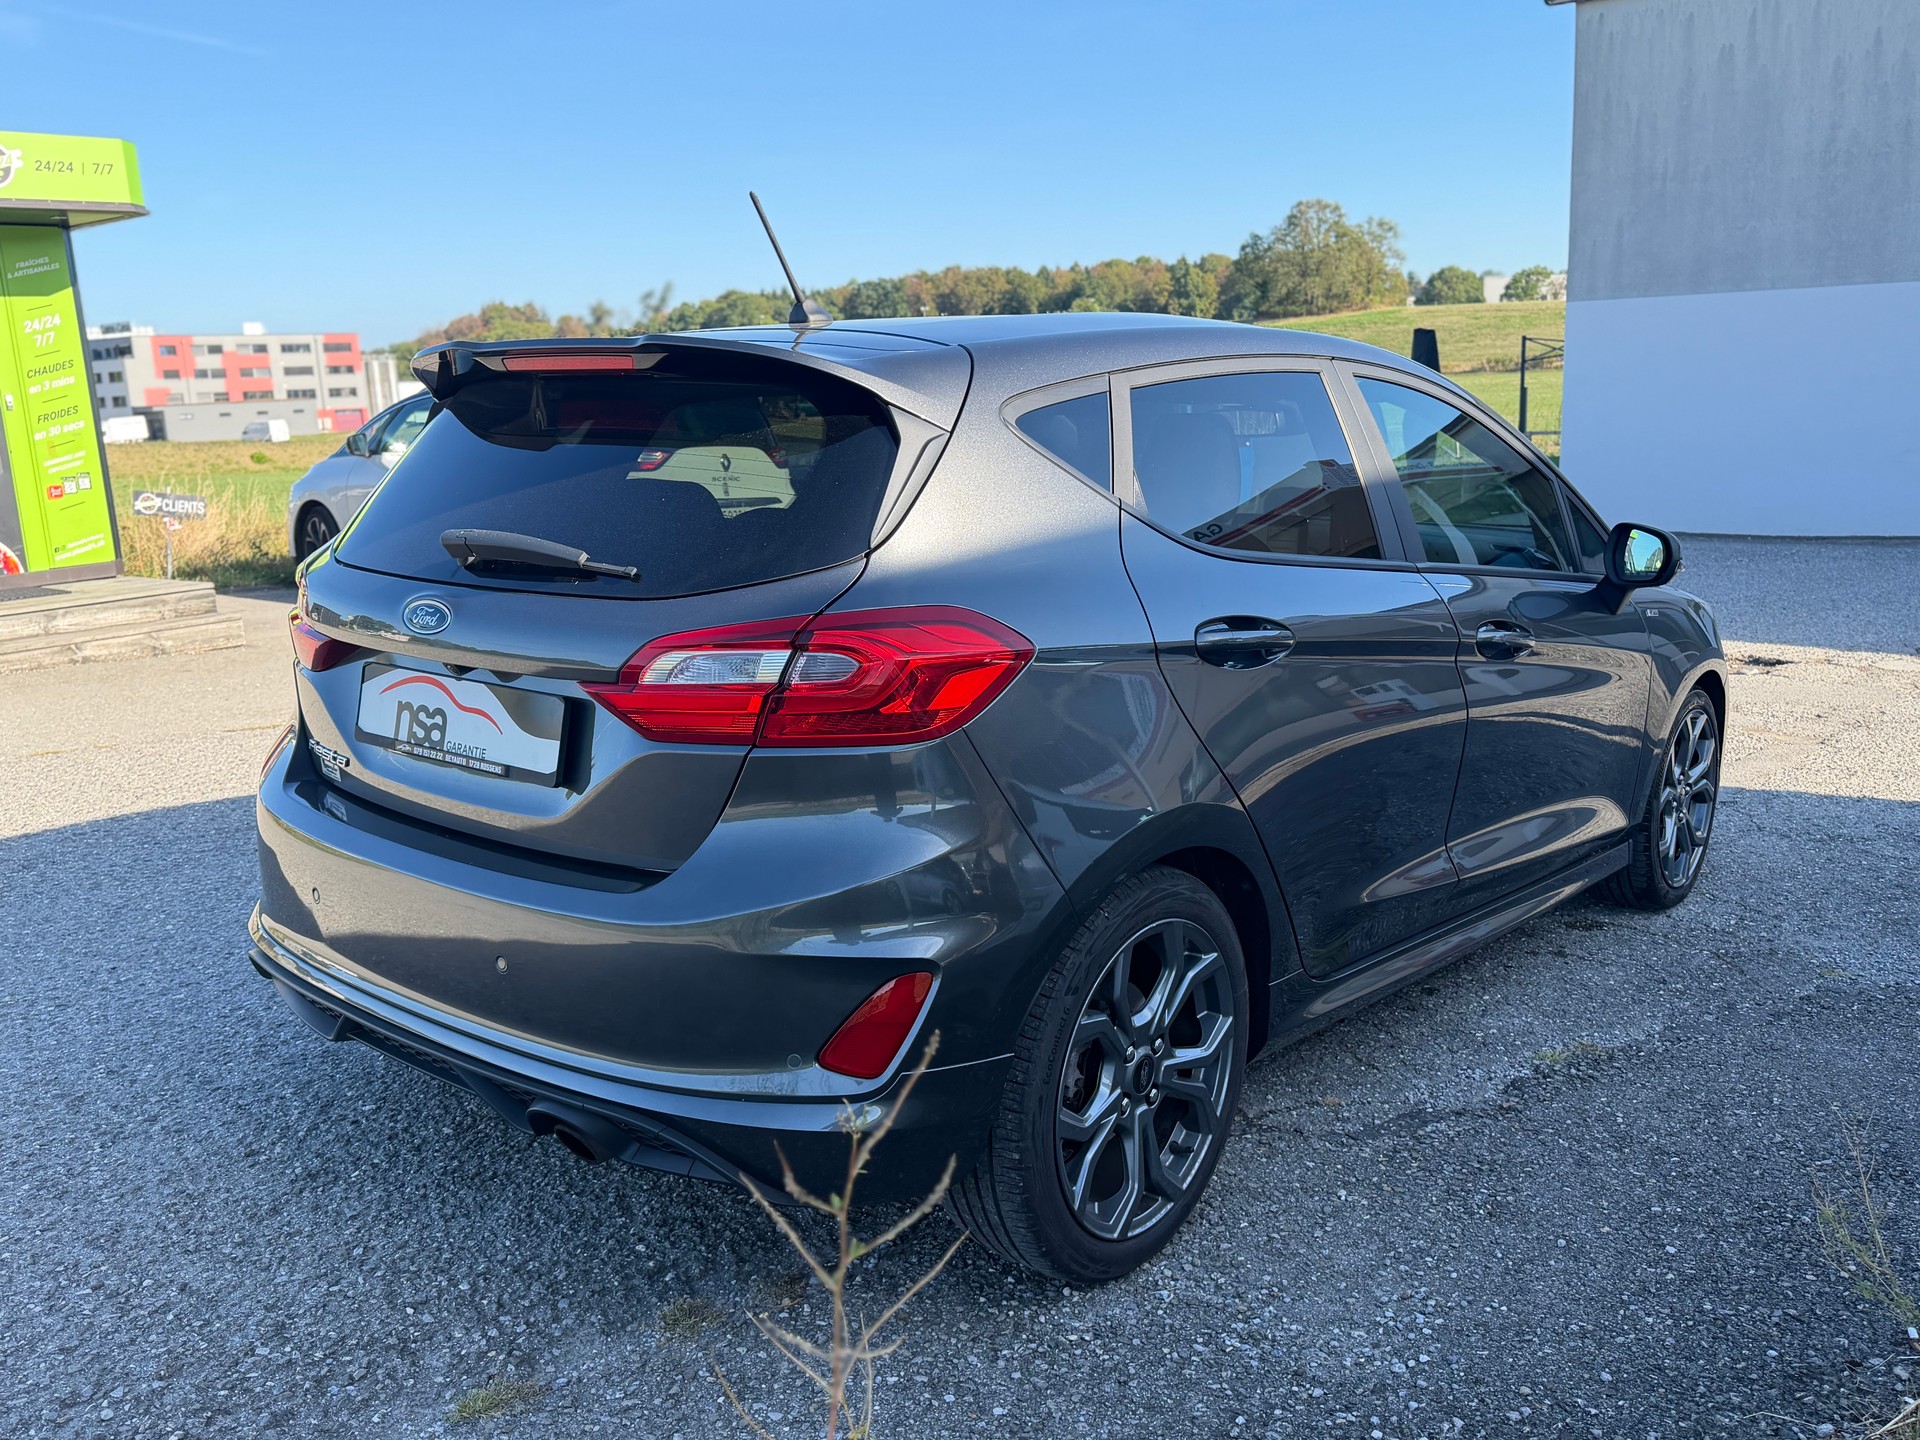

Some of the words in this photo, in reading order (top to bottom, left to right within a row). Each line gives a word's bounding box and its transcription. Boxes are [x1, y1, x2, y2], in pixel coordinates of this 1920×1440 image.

[34, 160, 74, 173] 24/24
[92, 163, 114, 175] 7/7
[13, 262, 60, 278] ARTISANALES
[23, 313, 61, 334] 24/24
[33, 331, 55, 348] 7/7
[26, 359, 75, 379] CHAUDES
[29, 384, 41, 394] en
[43, 380, 50, 391] 3
[51, 375, 76, 389] mins
[37, 405, 79, 425] FROIDES
[34, 430, 46, 441] en
[48, 425, 61, 437] 30
[162, 498, 205, 514] CLIENTS
[412, 606, 440, 625] Ford
[393, 700, 448, 751] nsa
[446, 740, 487, 759] GARANTIE
[1043, 1017, 1066, 1085] EcoContact
[1063, 1006, 1071, 1016] 6
